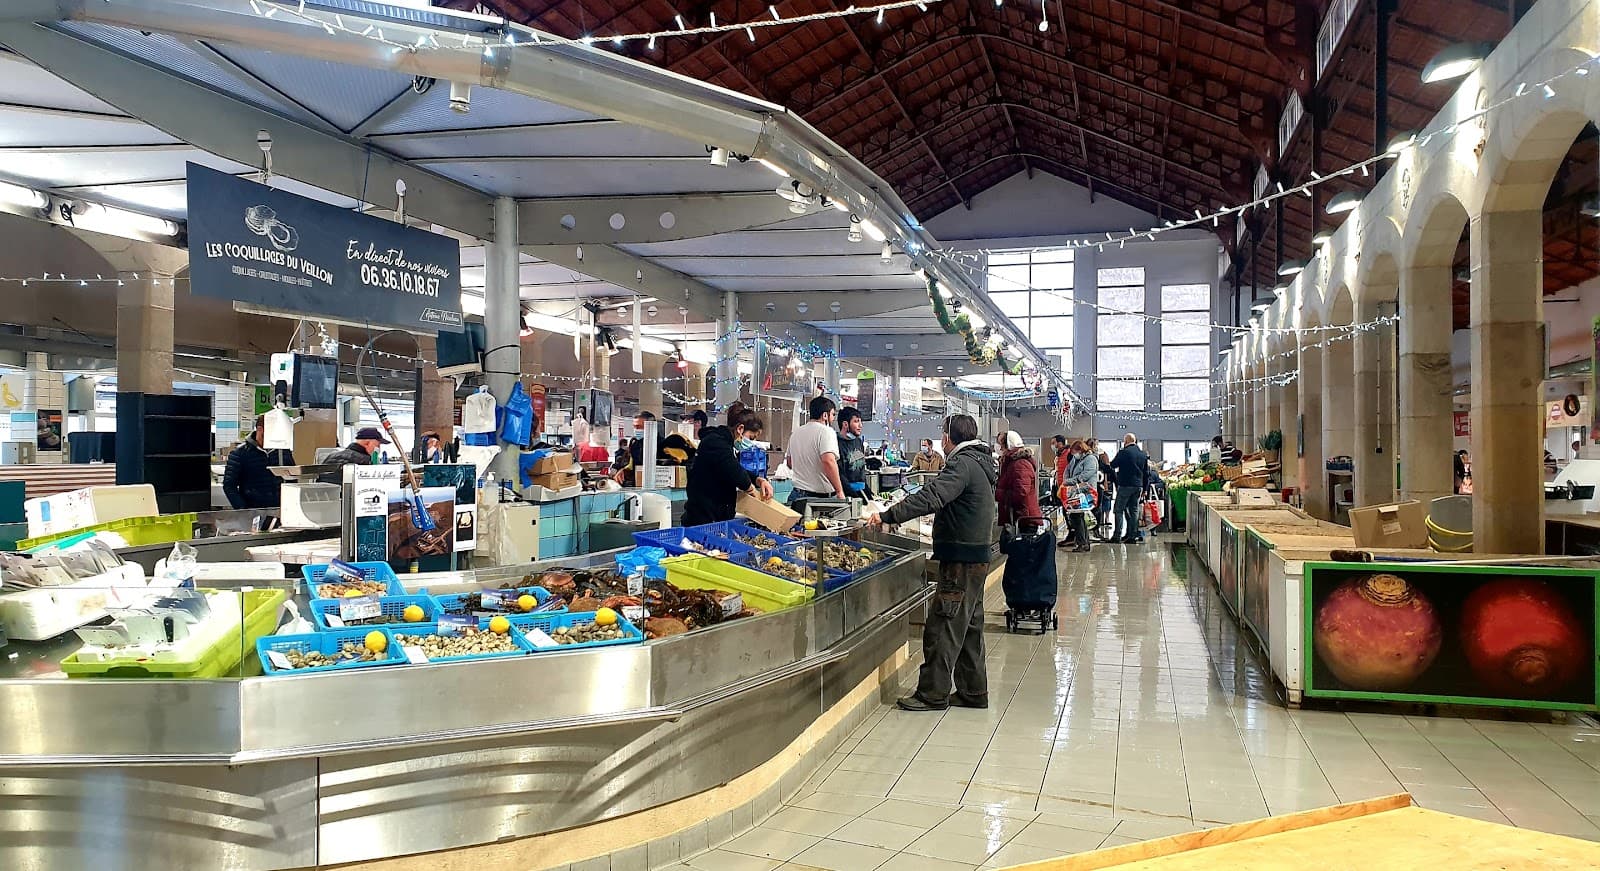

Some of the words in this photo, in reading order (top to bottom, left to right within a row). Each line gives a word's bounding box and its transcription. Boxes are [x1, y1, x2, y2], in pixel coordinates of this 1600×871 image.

[205, 241, 223, 258] LES
[224, 242, 285, 267] COQUILLAGES
[287, 254, 298, 269] DU
[300, 257, 333, 286] VEILLON
[347, 239, 363, 260] En
[364, 242, 399, 266] direct
[394, 249, 407, 268] de
[407, 261, 424, 272] nos
[424, 263, 450, 279] viviers
[360, 263, 440, 298] 06.36.10.18.67
